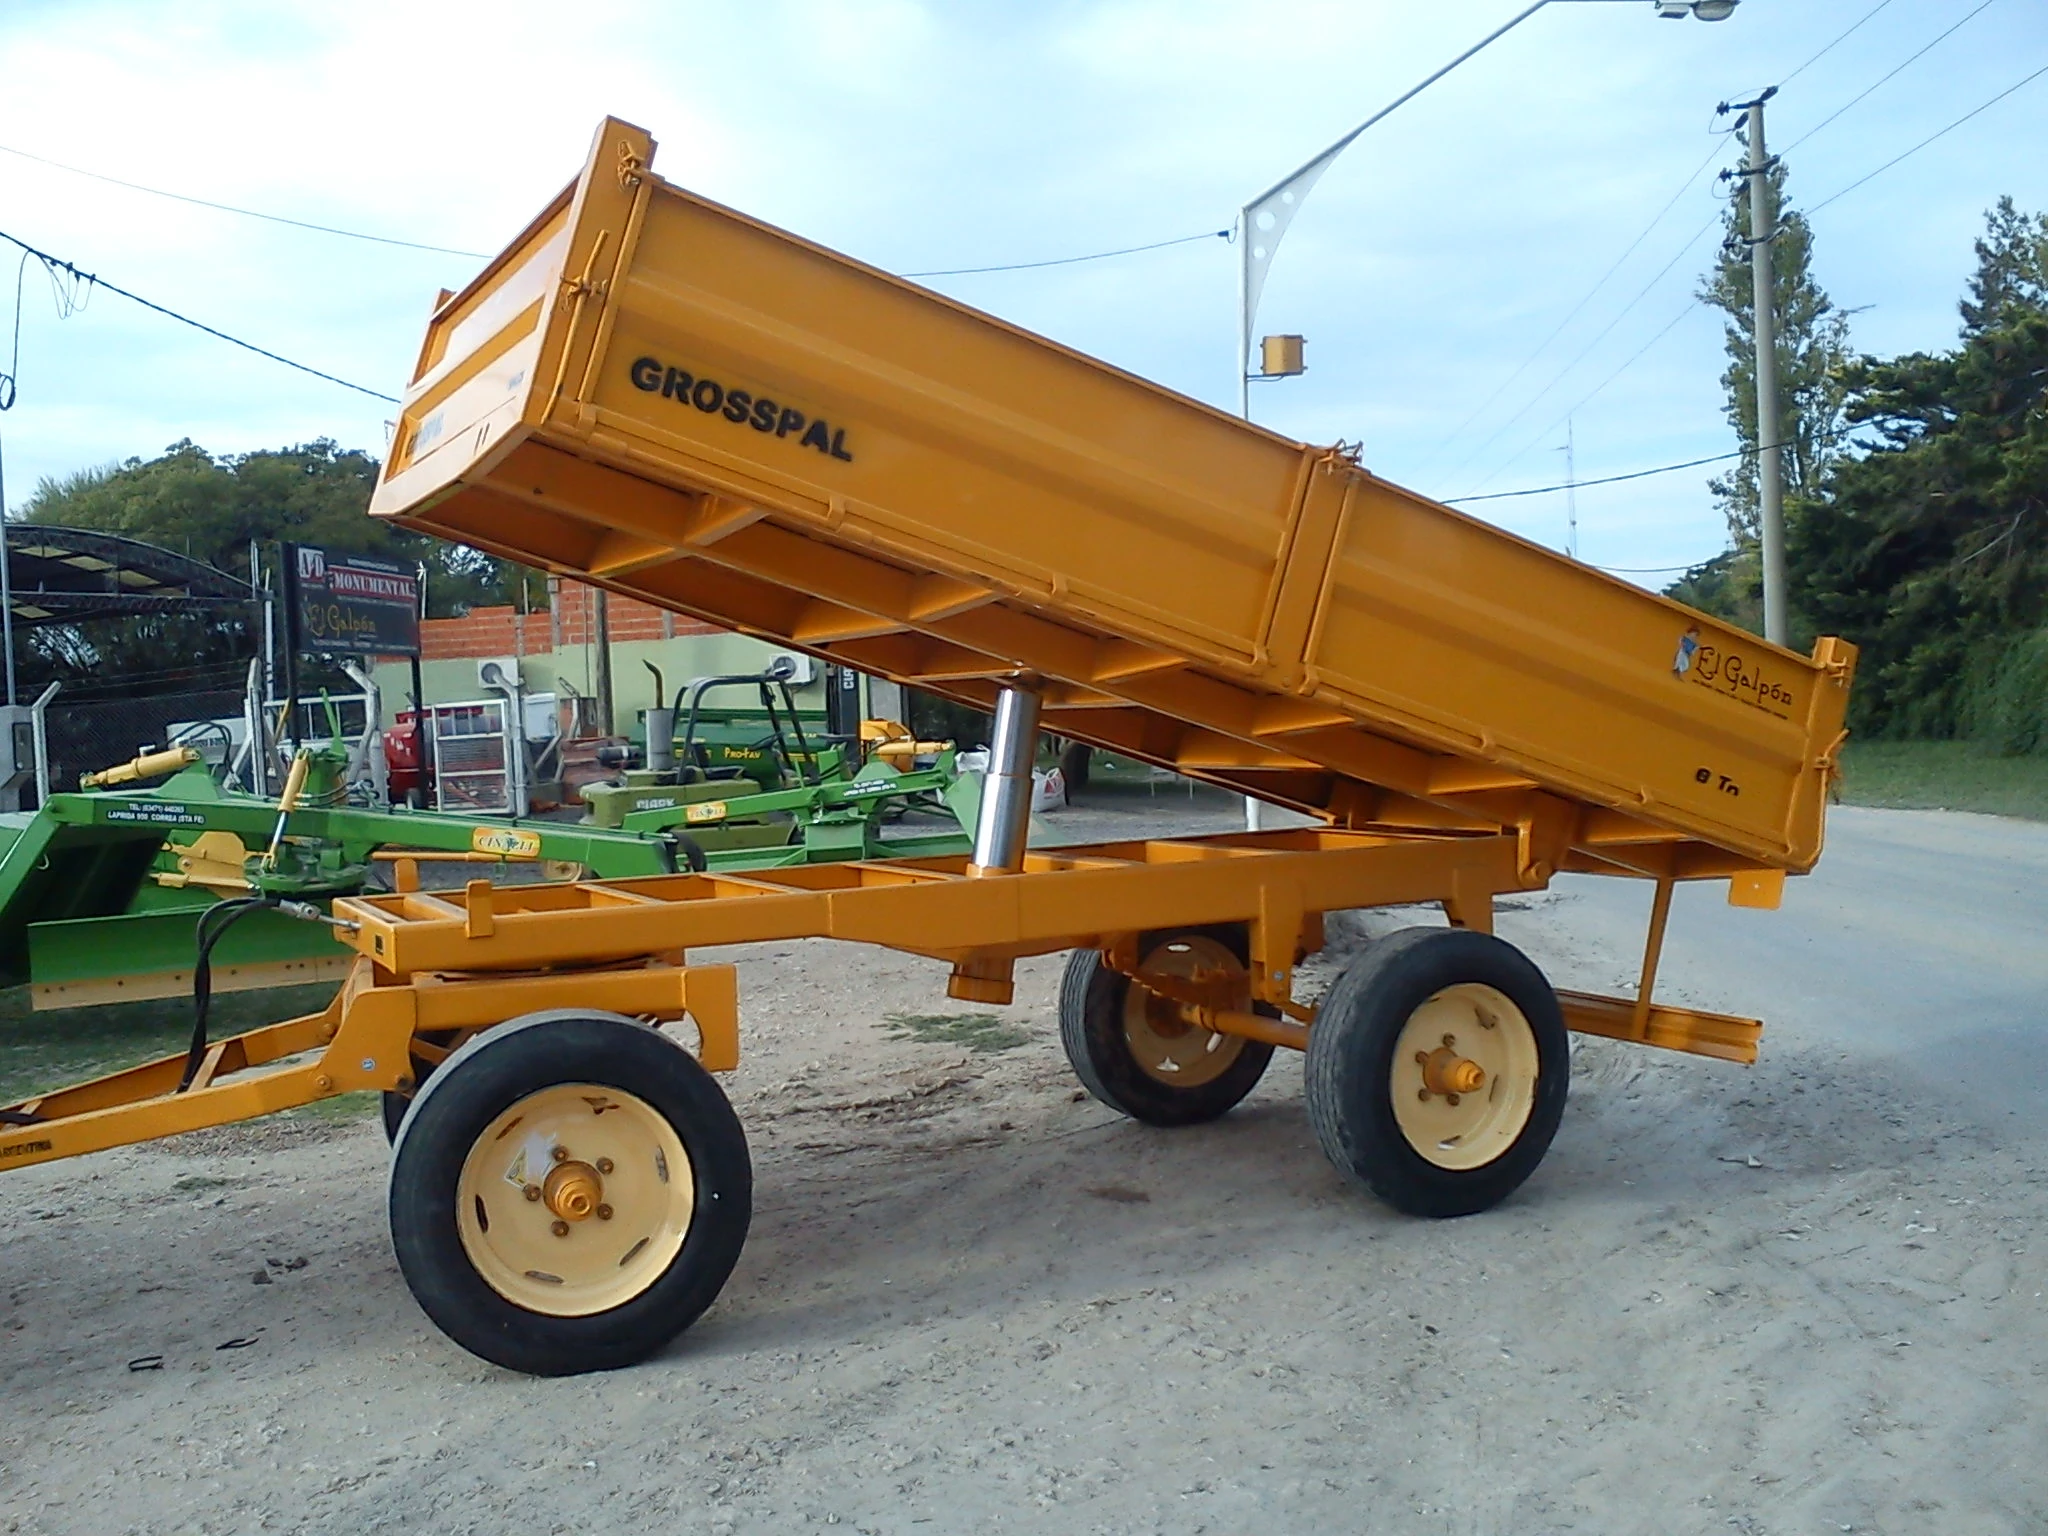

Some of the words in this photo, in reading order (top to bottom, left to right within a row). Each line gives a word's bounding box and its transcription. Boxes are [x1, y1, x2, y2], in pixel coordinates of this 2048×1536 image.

[631, 357, 852, 462] GROSSPAL
[334, 572, 412, 596] MONUMENTAL
[308, 604, 325, 637] El
[327, 604, 376, 638] Galpón
[1696, 645, 1721, 680] El
[1724, 655, 1793, 705] Galpón
[636, 798, 675, 810] CLARK
